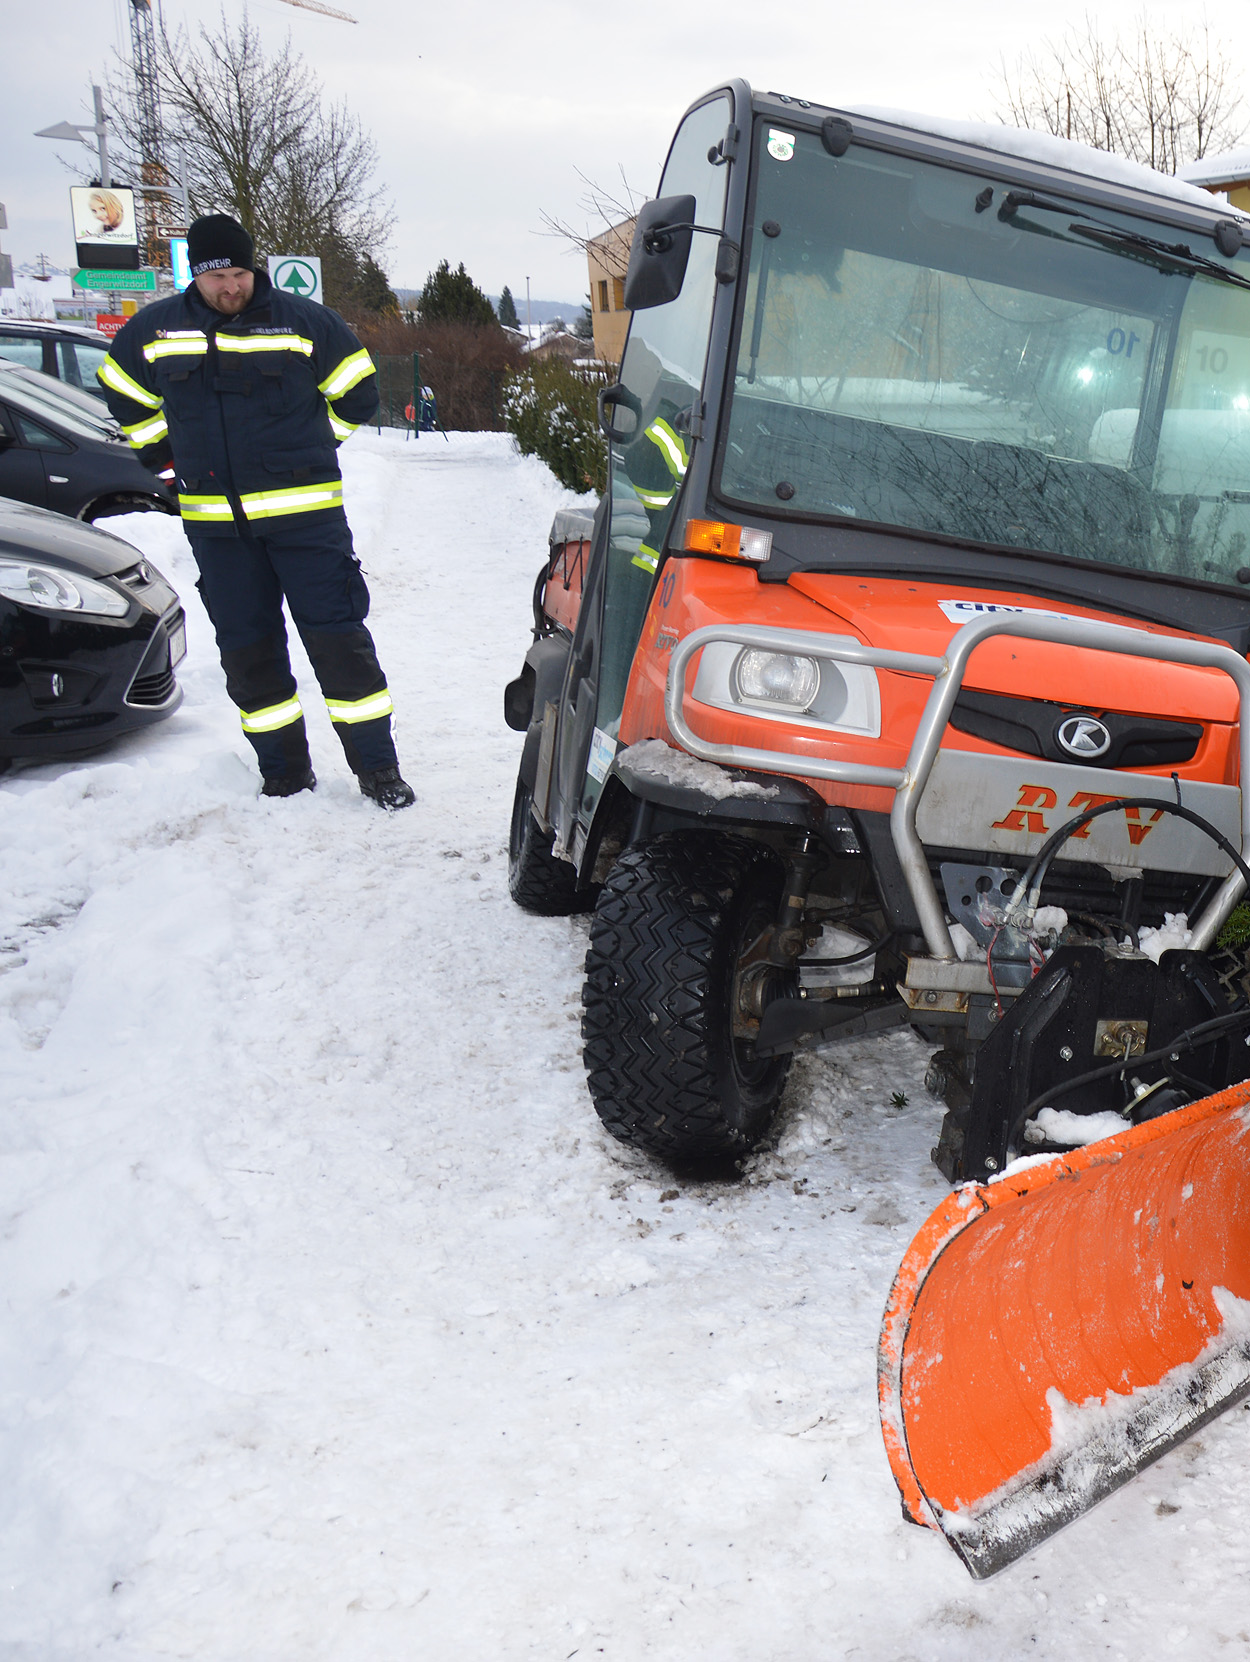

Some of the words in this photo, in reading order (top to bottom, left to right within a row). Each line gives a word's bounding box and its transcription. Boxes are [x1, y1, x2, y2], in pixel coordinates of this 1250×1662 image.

[86, 271, 146, 280] Gemeindeamt
[87, 280, 147, 290] Engerwitzdorf
[659, 571, 675, 609] 10
[991, 784, 1165, 845] RTV
